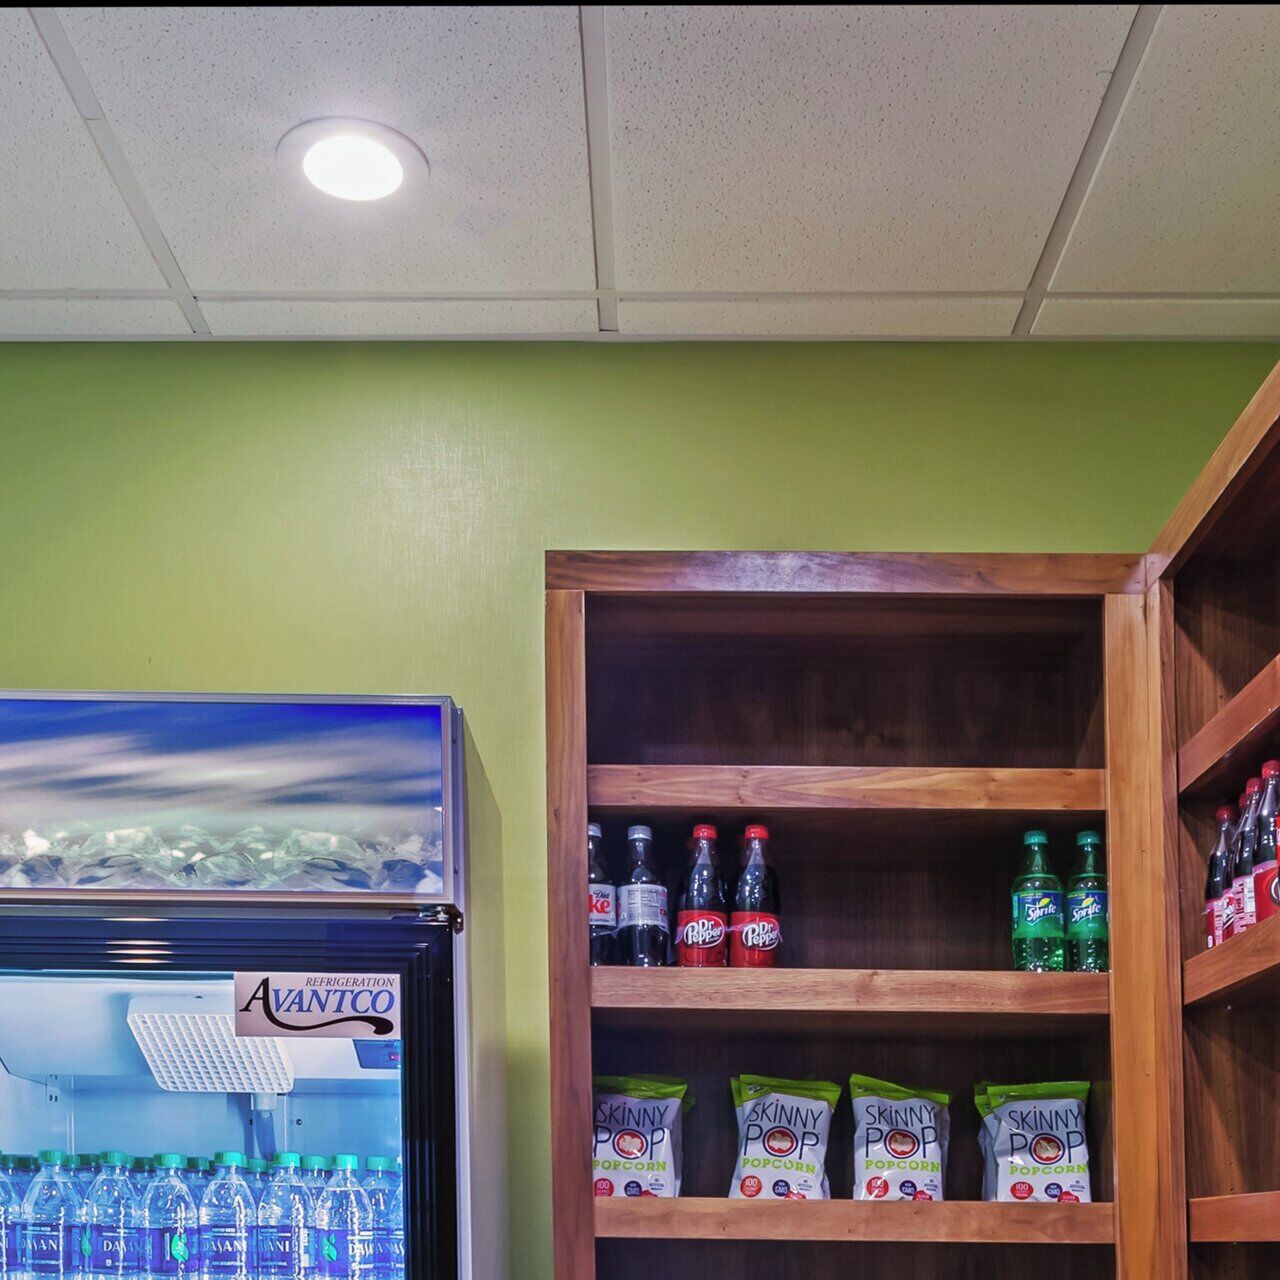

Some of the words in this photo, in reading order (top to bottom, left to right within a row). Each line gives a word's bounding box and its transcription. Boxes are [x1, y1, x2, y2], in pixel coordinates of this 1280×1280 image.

[1026, 903, 1057, 921] Sprite
[688, 923, 722, 945] Pepper
[304, 977, 395, 988] REFRIGERATION
[238, 976, 395, 1021] AVANTCO
[595, 1101, 669, 1128] SKINNY
[748, 1099, 823, 1130] SKINNY
[865, 1104, 937, 1127] SKINNY
[1008, 1106, 1081, 1131] SKINNY
[593, 1124, 666, 1160] POP
[743, 1124, 820, 1160] POP
[865, 1126, 938, 1159] POP
[1009, 1130, 1085, 1165] POP
[592, 1159, 667, 1172] POPCORN
[742, 1157, 816, 1174] POPCORN
[865, 1159, 940, 1173] POPCORN
[1009, 1164, 1088, 1175] POPCORN
[203, 1239, 247, 1251] DASANI
